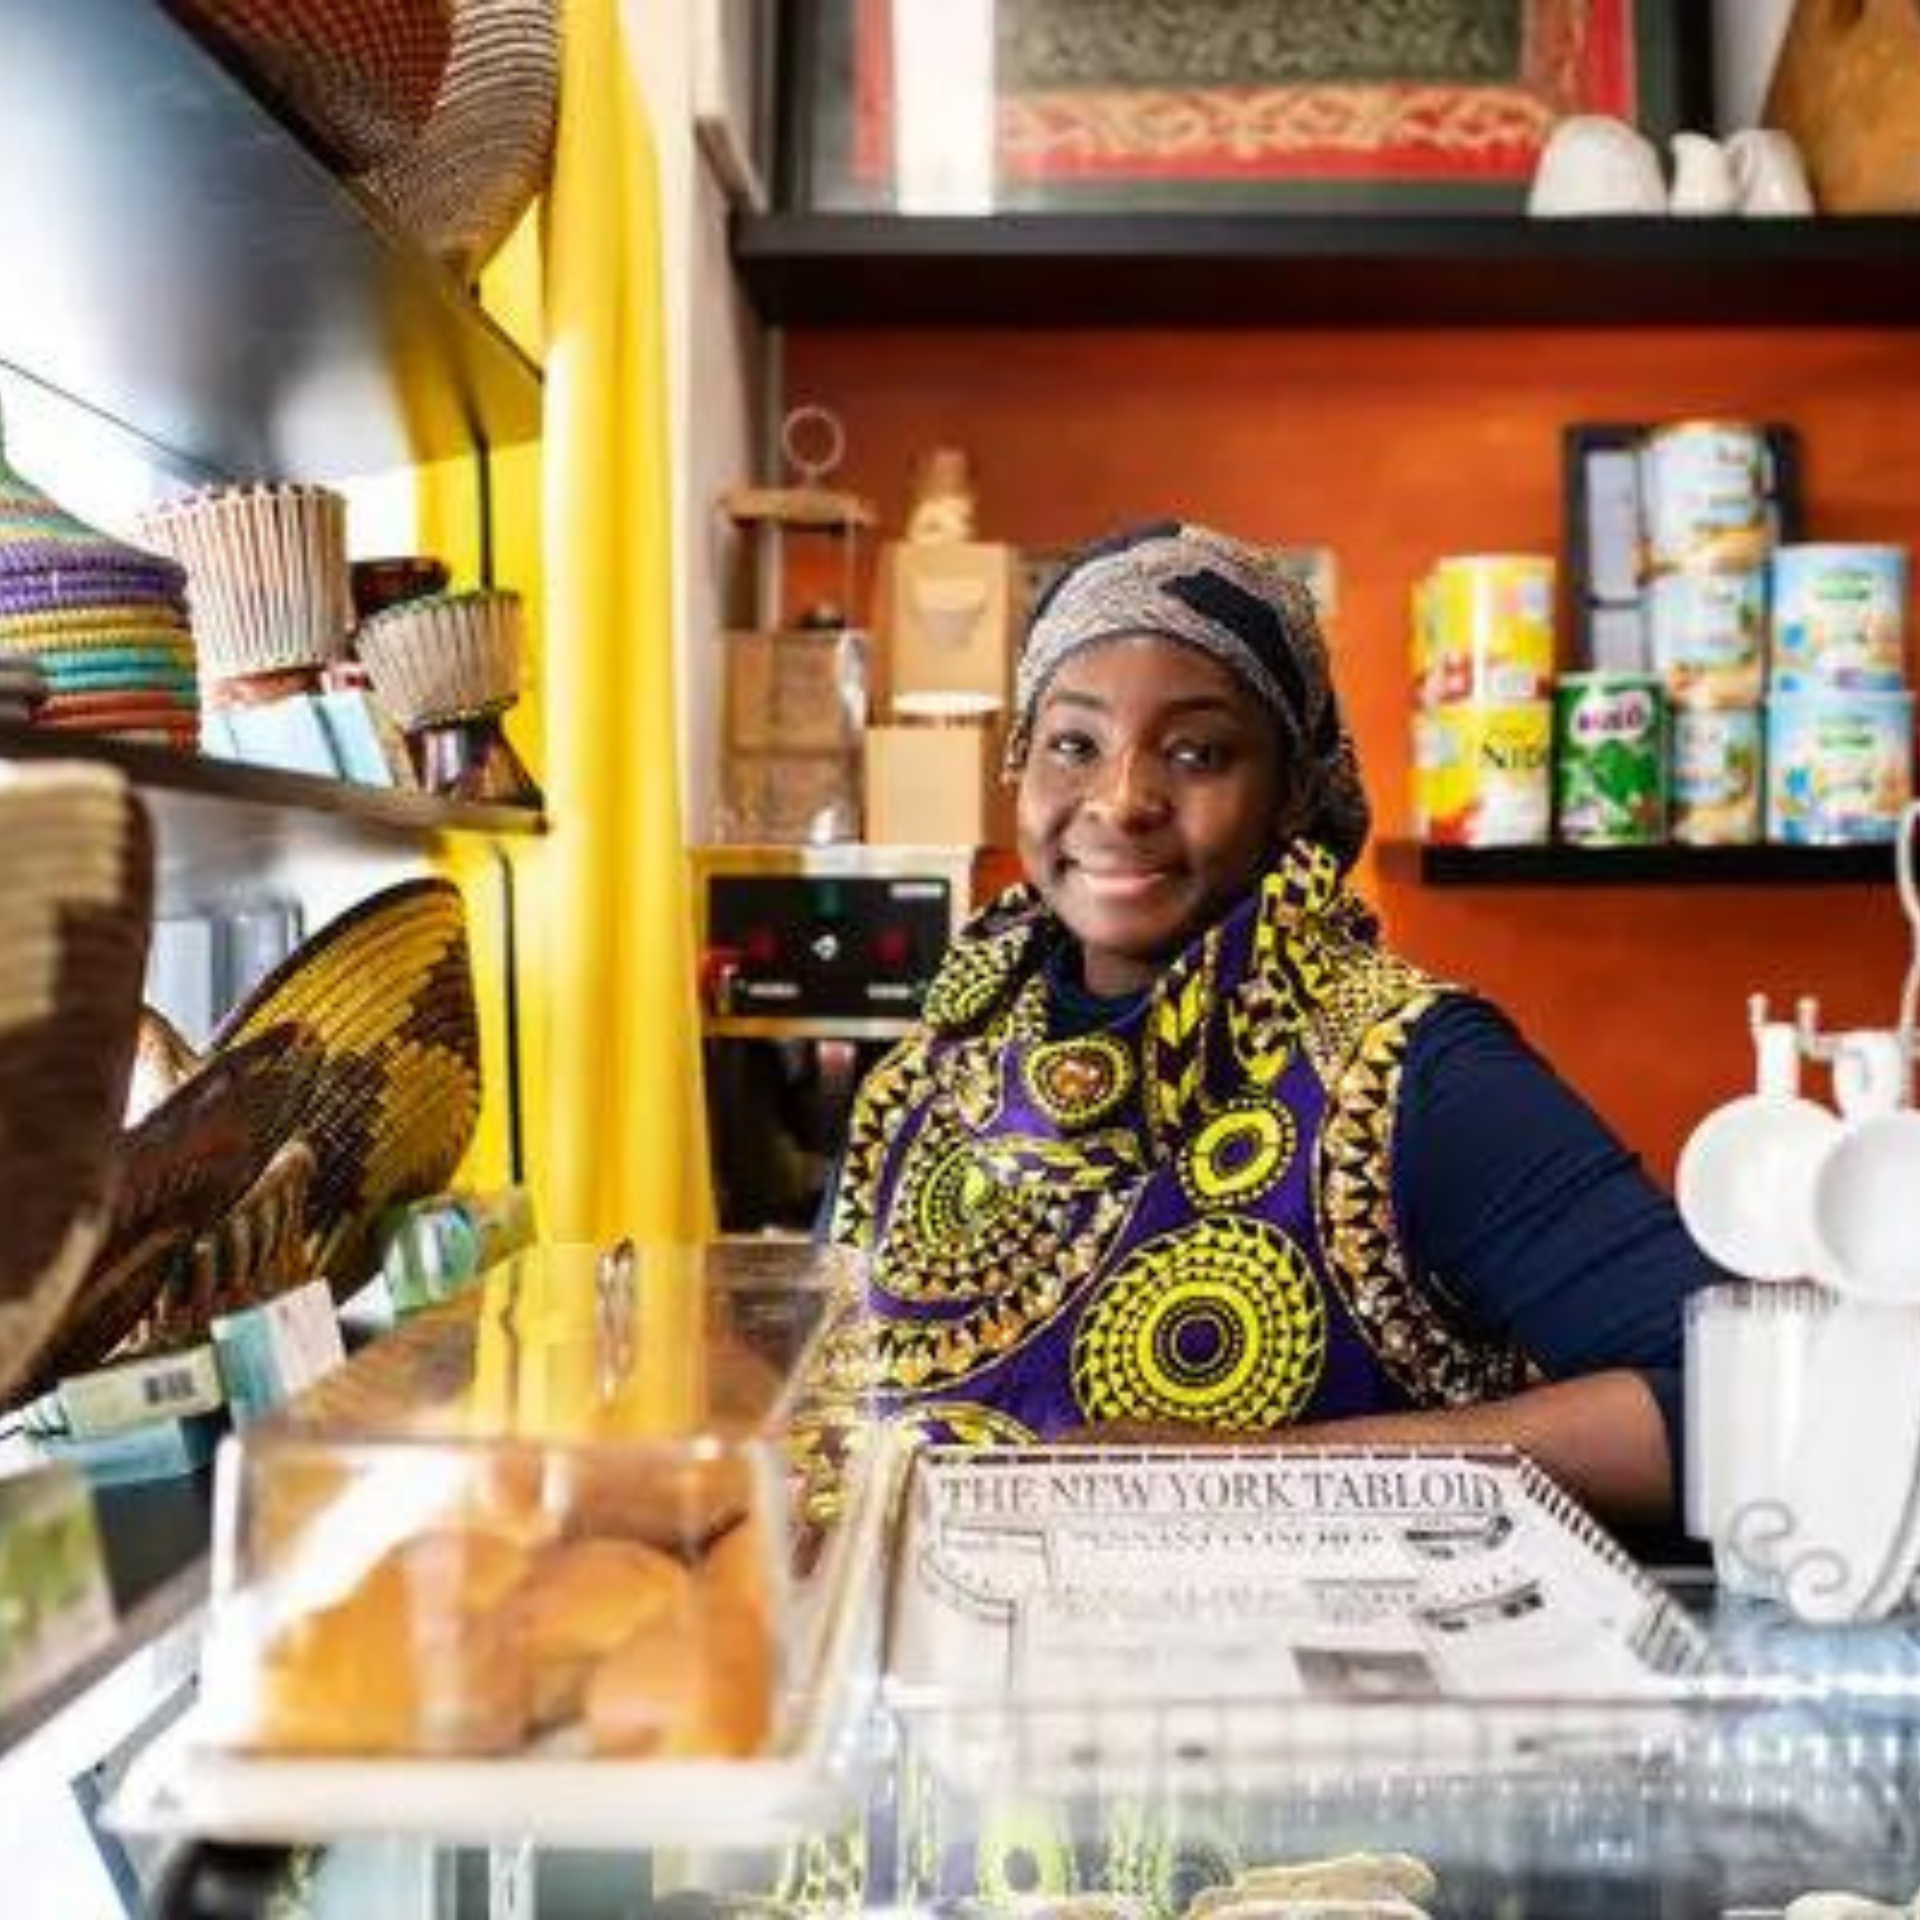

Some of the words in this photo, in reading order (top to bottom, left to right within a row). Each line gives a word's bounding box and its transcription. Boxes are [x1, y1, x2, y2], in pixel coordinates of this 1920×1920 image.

[940, 1477, 1046, 1513] THE
[1050, 1474, 1154, 1509] NEW
[1164, 1473, 1299, 1508] YORK
[1300, 1472, 1504, 1509] TABLOID
